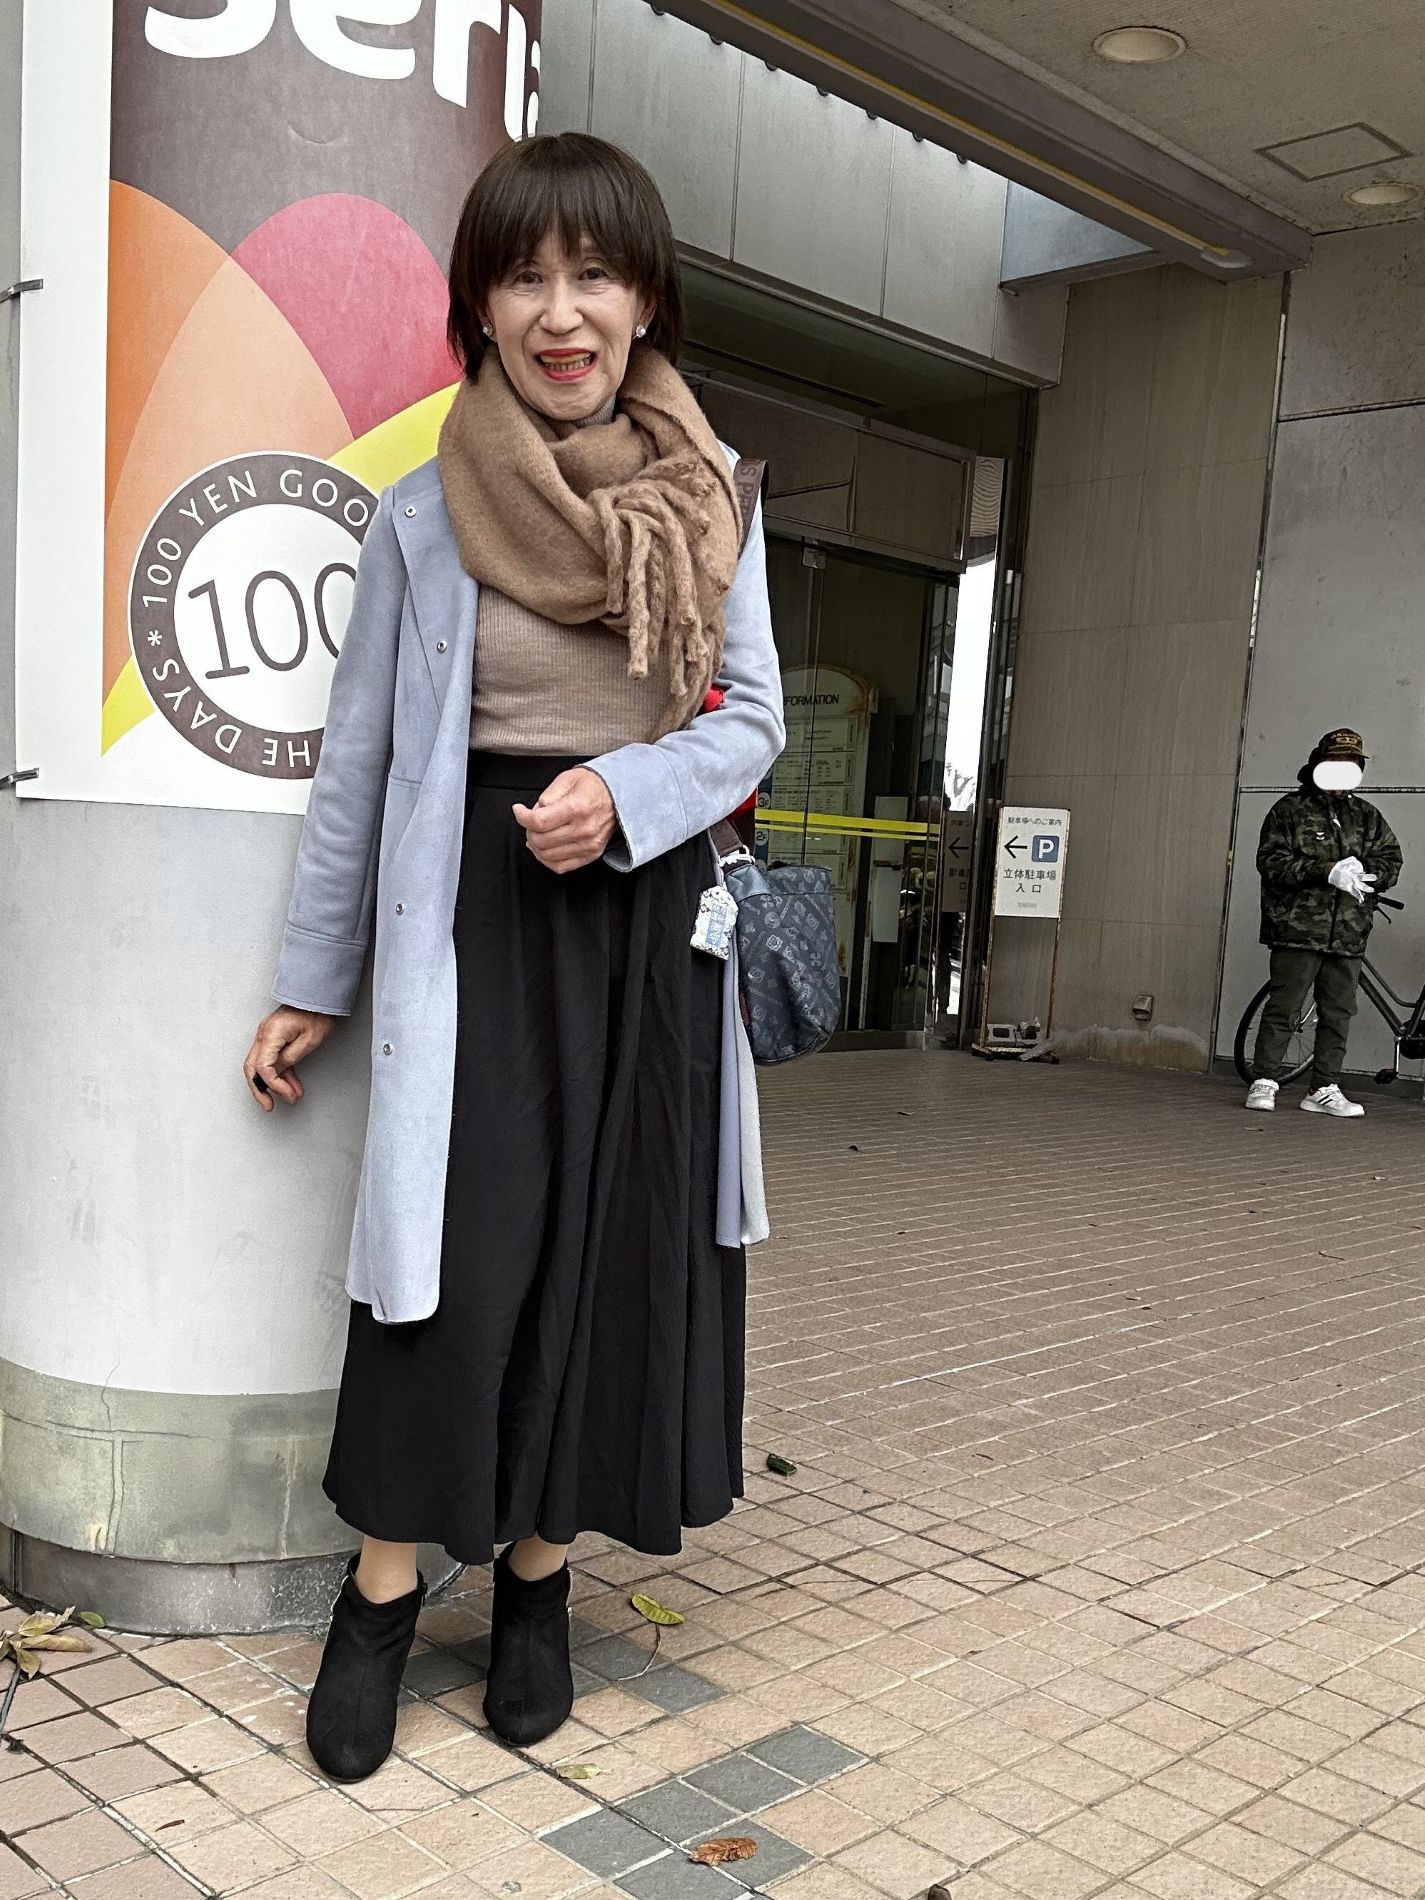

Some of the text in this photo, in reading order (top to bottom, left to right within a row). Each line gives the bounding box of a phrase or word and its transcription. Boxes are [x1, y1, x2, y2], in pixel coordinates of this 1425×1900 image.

[143, 538, 182, 607] 100
[179, 470, 257, 527] YEN
[188, 563, 357, 680] 100
[153, 659, 242, 754] DAYS
[1008, 817, 1062, 826] 駐車場へのご案内
[1039, 839, 1054, 859] P
[1003, 868, 1057, 881] 立体駐車場
[1015, 882, 1041, 894] 入口
